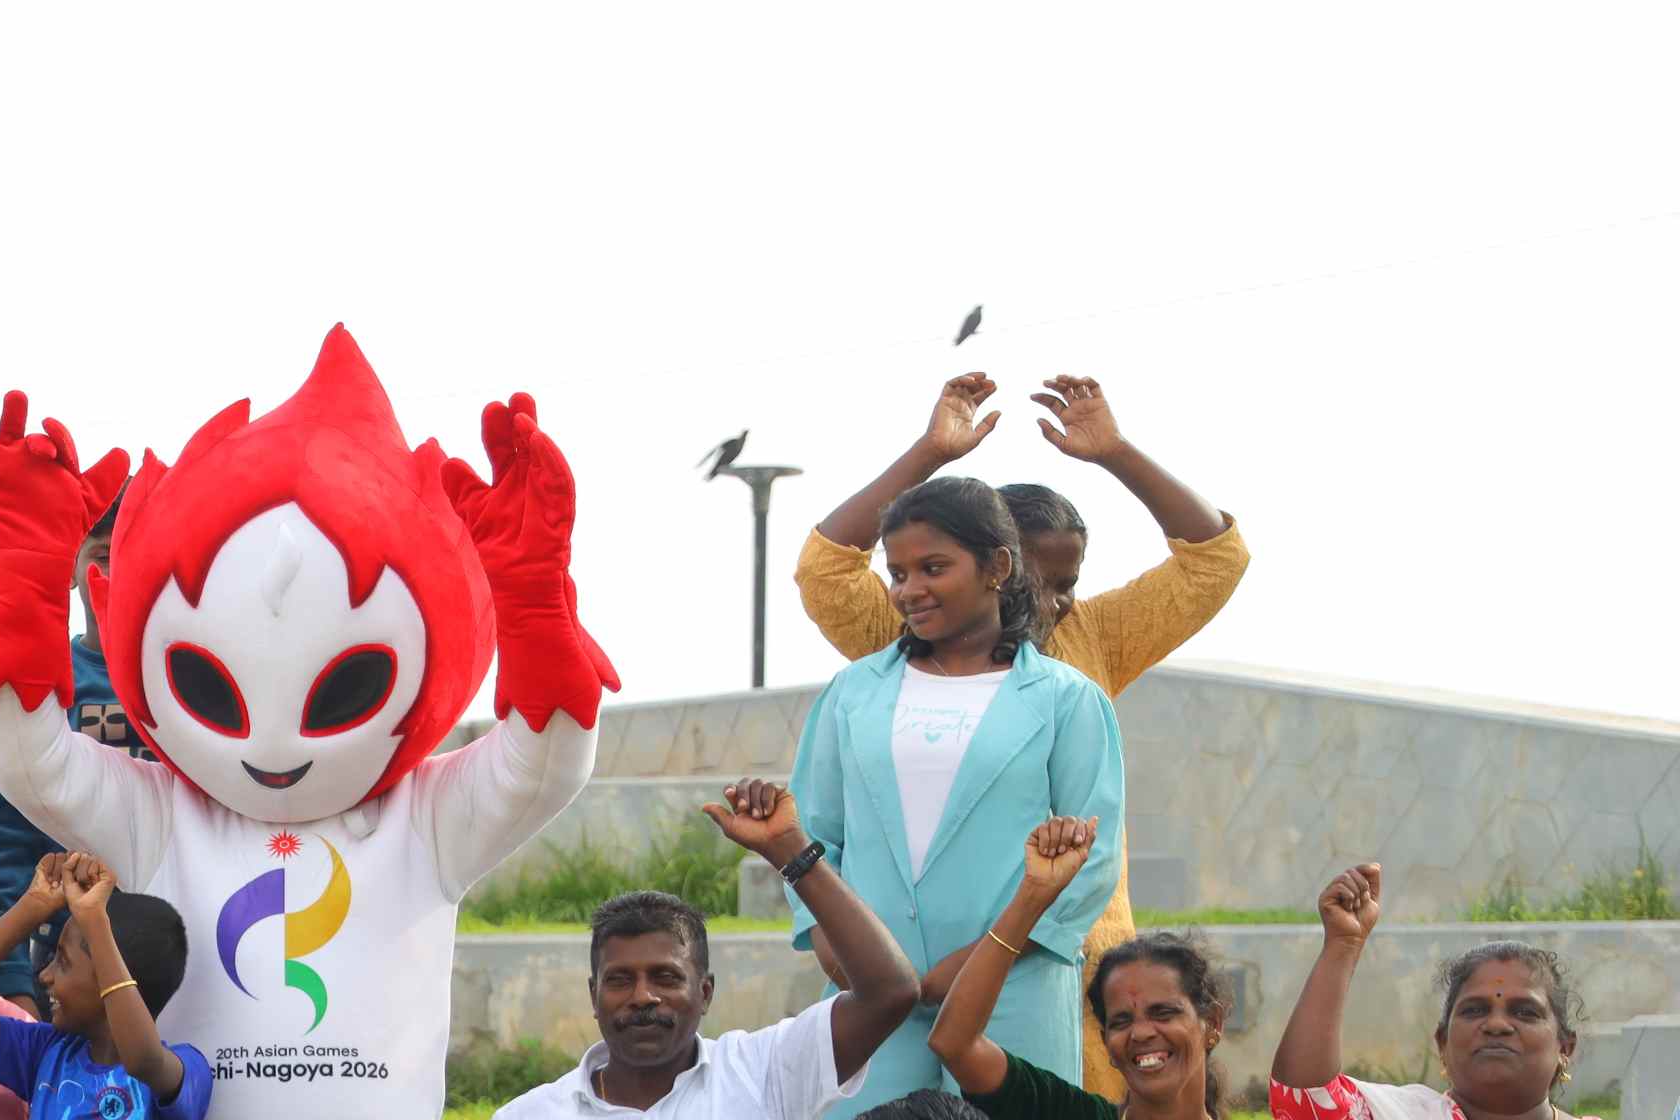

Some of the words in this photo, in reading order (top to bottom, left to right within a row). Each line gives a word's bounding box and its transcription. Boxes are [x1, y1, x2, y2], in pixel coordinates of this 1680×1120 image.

[216, 1046, 249, 1060] 20th
[254, 1045, 298, 1057] Asian
[303, 1044, 359, 1057] Games
[340, 1061, 389, 1079] 2026
